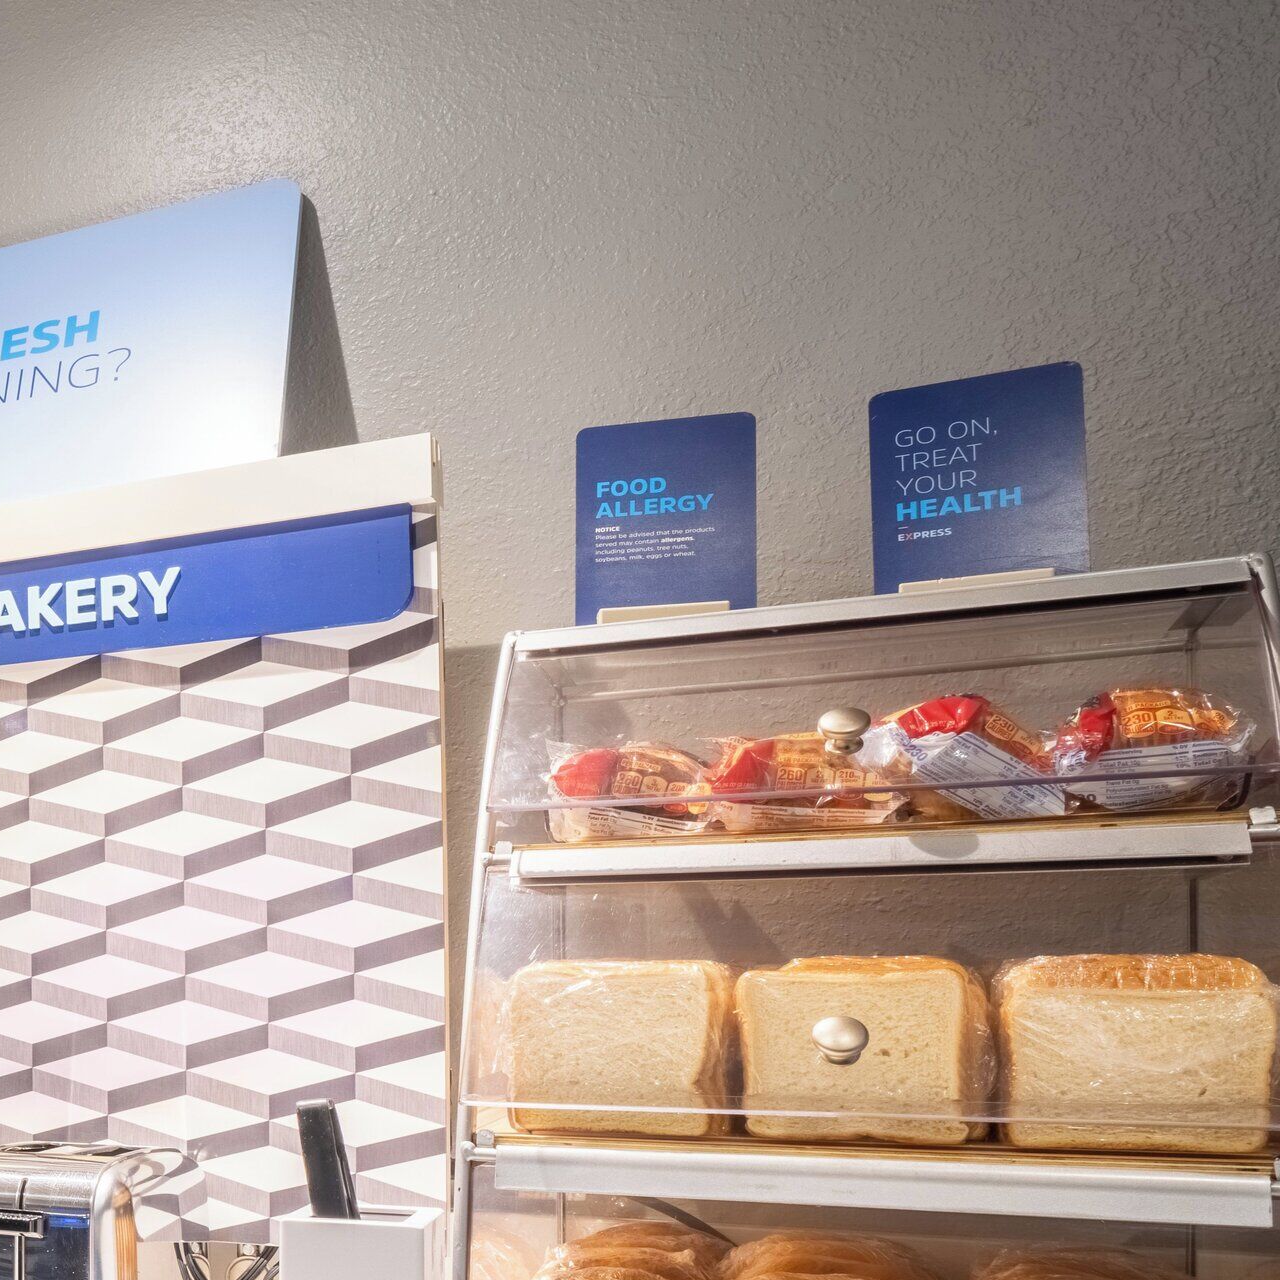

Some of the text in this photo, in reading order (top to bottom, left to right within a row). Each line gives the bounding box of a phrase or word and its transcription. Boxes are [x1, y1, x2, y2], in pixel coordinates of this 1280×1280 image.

[895, 417, 997, 448] GO ON,
[895, 442, 983, 472] TREAT
[596, 476, 667, 498] FOOD
[896, 469, 977, 496] YOUR
[595, 493, 715, 519] ALLERGY
[896, 486, 1022, 522] HEALTH
[595, 526, 620, 534] NOTICE
[595, 533, 617, 541] Please
[628, 531, 655, 539] advised
[684, 526, 716, 534] products
[897, 527, 953, 542] EXPRESS
[595, 541, 618, 549] served
[618, 540, 633, 548] may
[595, 548, 625, 556] including
[992, 715, 1016, 733] 230
[1123, 712, 1150, 725] 230
[906, 745, 927, 761] 230
[778, 769, 803, 781] 260
